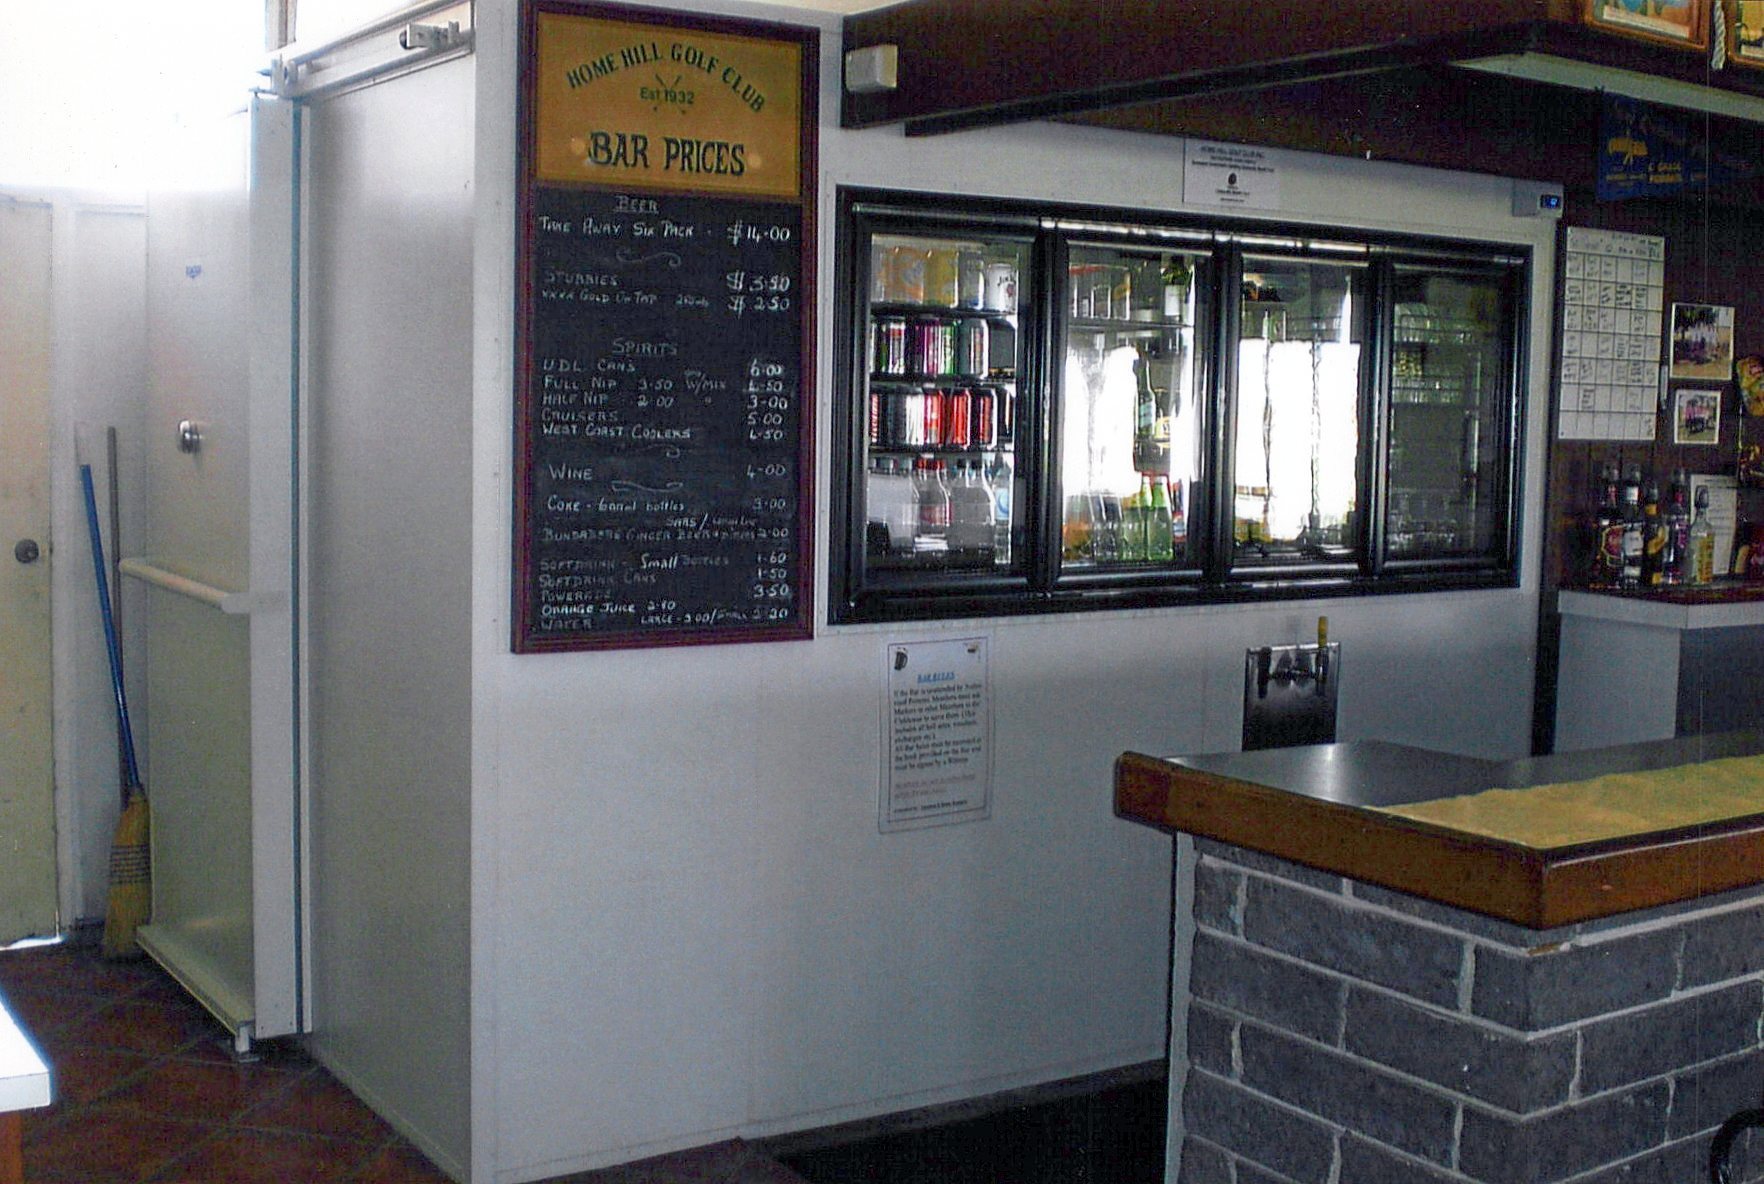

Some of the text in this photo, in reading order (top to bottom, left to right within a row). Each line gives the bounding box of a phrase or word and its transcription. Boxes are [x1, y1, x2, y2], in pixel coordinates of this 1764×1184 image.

[567, 42, 766, 113] HOME HILL GOLF CLUB
[588, 132, 746, 177] BAR PRICES
[611, 337, 678, 357] SPIRITS
[548, 464, 593, 481] WINE
